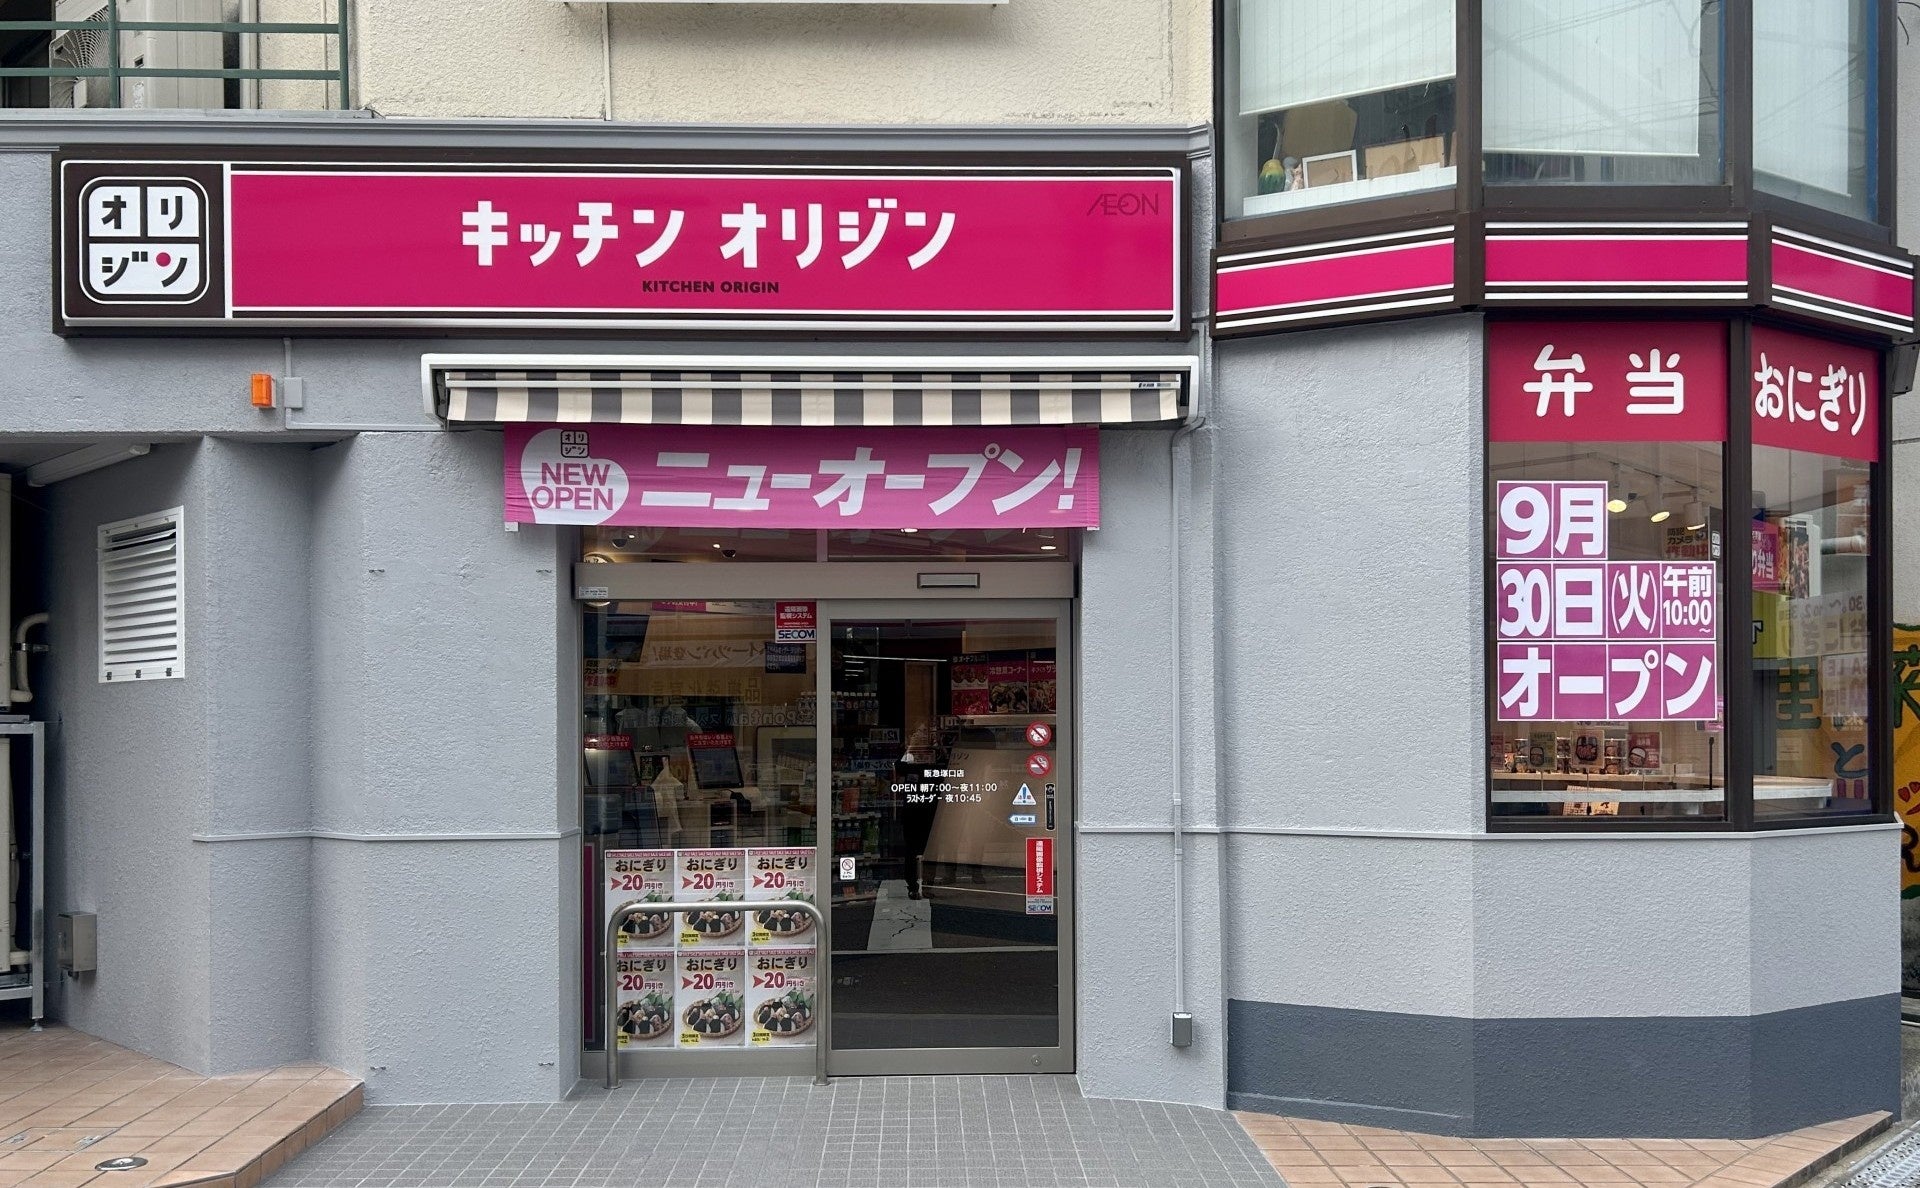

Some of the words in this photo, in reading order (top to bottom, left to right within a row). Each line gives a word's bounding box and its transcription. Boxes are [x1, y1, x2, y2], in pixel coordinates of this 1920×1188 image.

[462, 201, 685, 268] キッチン
[720, 198, 956, 270] オリジン
[642, 281, 715, 293] KITCHEN
[720, 281, 780, 294] ORIGIN
[1523, 344, 1685, 417] 弁当
[1754, 352, 1868, 436] おにぎり
[541, 462, 611, 487] NEW
[641, 442, 1082, 517] ニューオープン!
[532, 486, 614, 511] OPEN
[1500, 486, 1604, 556] 9月
[1662, 566, 1712, 598] 午前
[778, 630, 815, 639] SECOM
[1500, 647, 1712, 717] オープン
[924, 769, 965, 778] 阪急塚口店
[891, 784, 917, 792] OPEN
[615, 858, 667, 872] おにぎり
[686, 858, 738, 871] おにぎり
[757, 857, 808, 871] おにぎり
[686, 957, 738, 971] おにぎり
[757, 957, 808, 971] おにぎり
